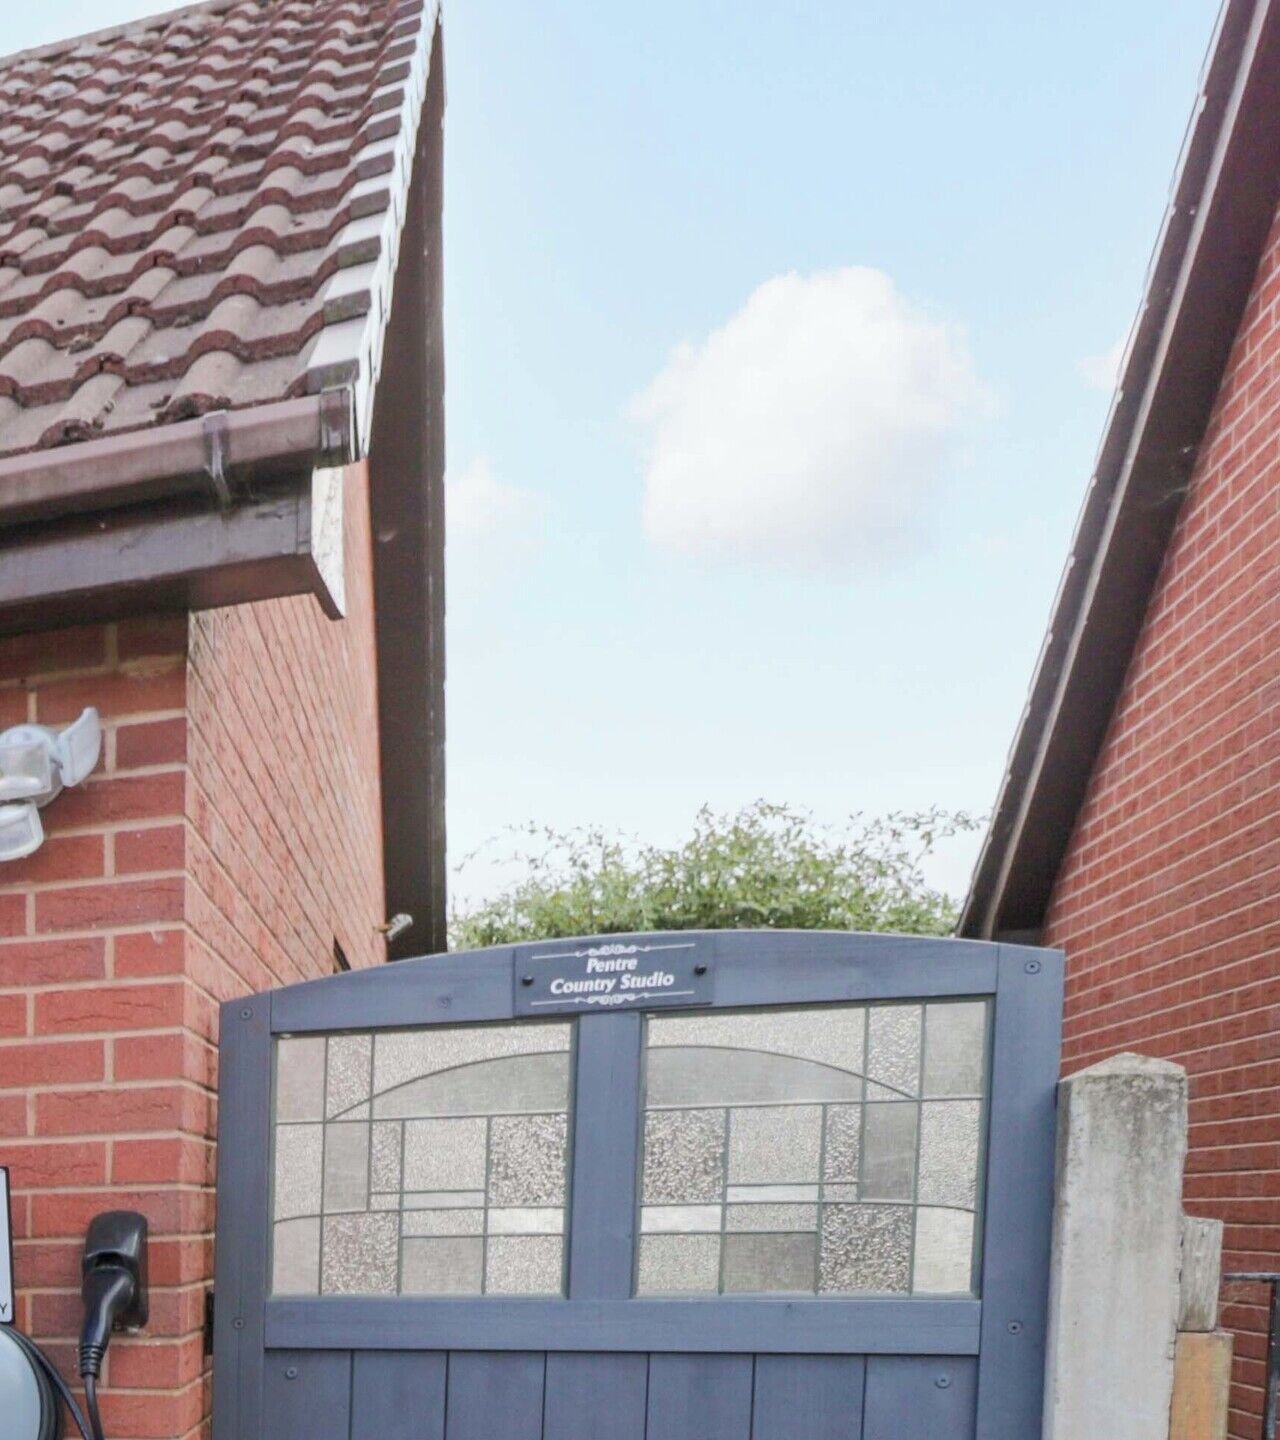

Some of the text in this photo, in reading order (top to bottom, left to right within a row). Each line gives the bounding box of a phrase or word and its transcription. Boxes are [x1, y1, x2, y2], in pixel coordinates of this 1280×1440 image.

[586, 957, 638, 974] Pentre
[550, 973, 675, 995] Country Studio
